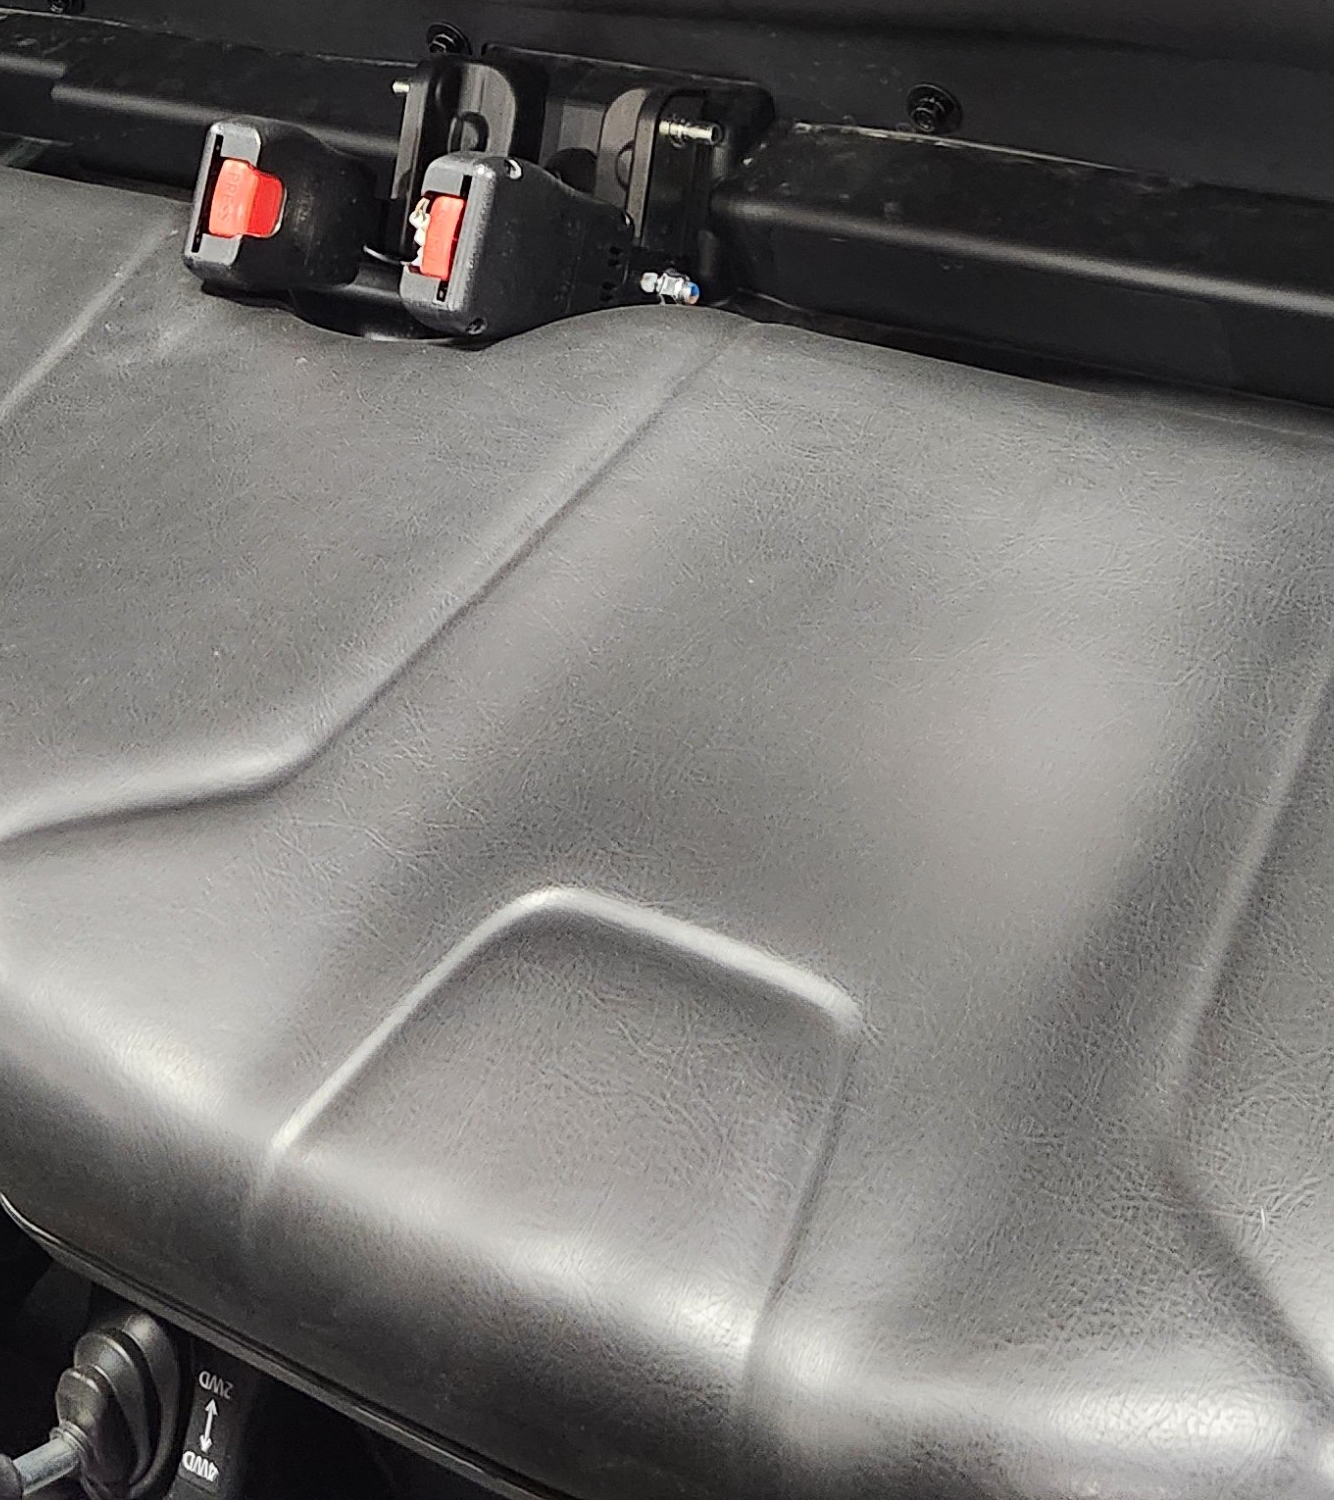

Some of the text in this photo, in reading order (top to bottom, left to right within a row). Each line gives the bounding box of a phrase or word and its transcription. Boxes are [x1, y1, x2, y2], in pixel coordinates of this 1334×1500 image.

[218, 172, 240, 221] PRESS
[198, 1370, 234, 1400] 2WD
[182, 1450, 220, 1482] 4WD
